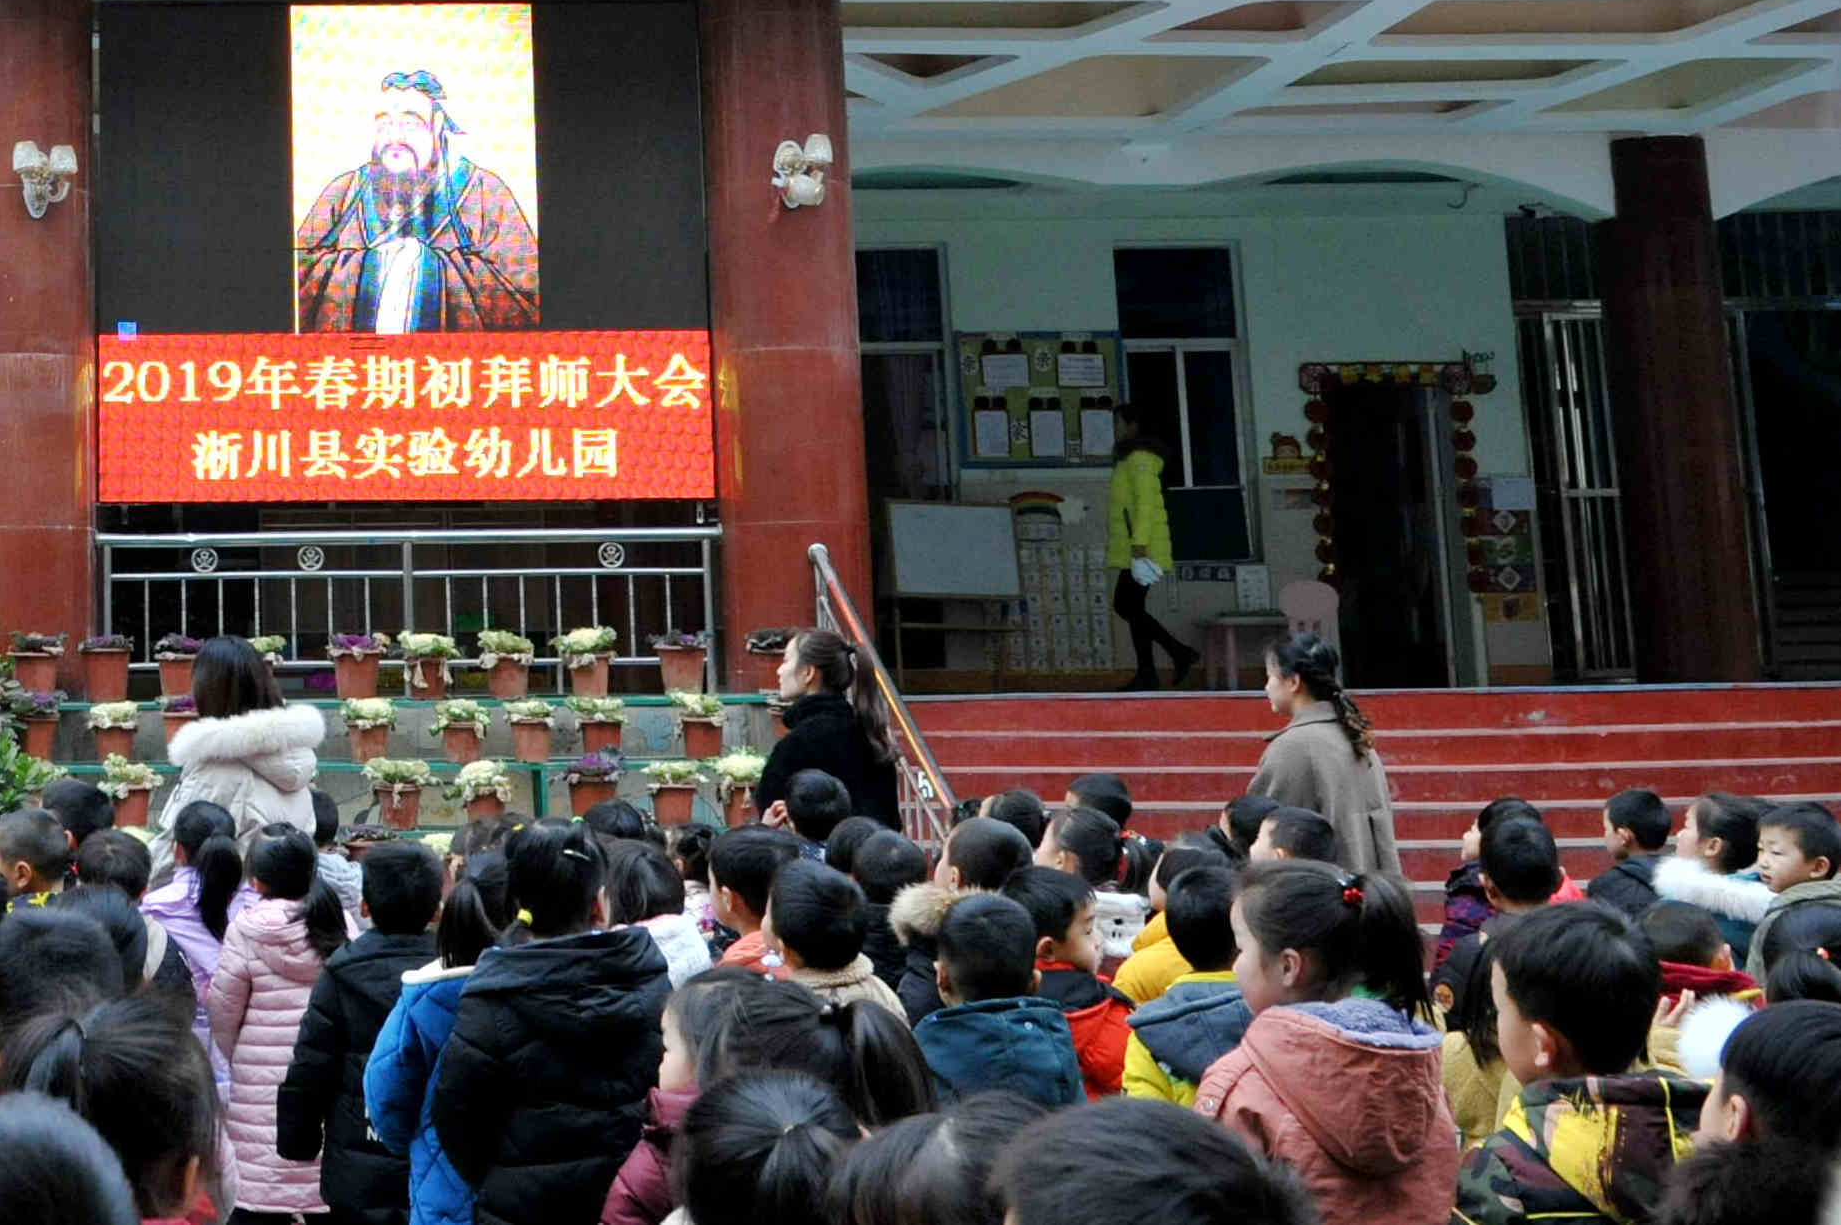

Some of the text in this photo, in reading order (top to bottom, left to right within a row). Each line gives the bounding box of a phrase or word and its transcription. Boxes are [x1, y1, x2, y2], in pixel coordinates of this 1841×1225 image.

[101, 352, 707, 410] 2019年春期初拜师大会
[190, 427, 620, 481] 淅川县实验幼儿园
